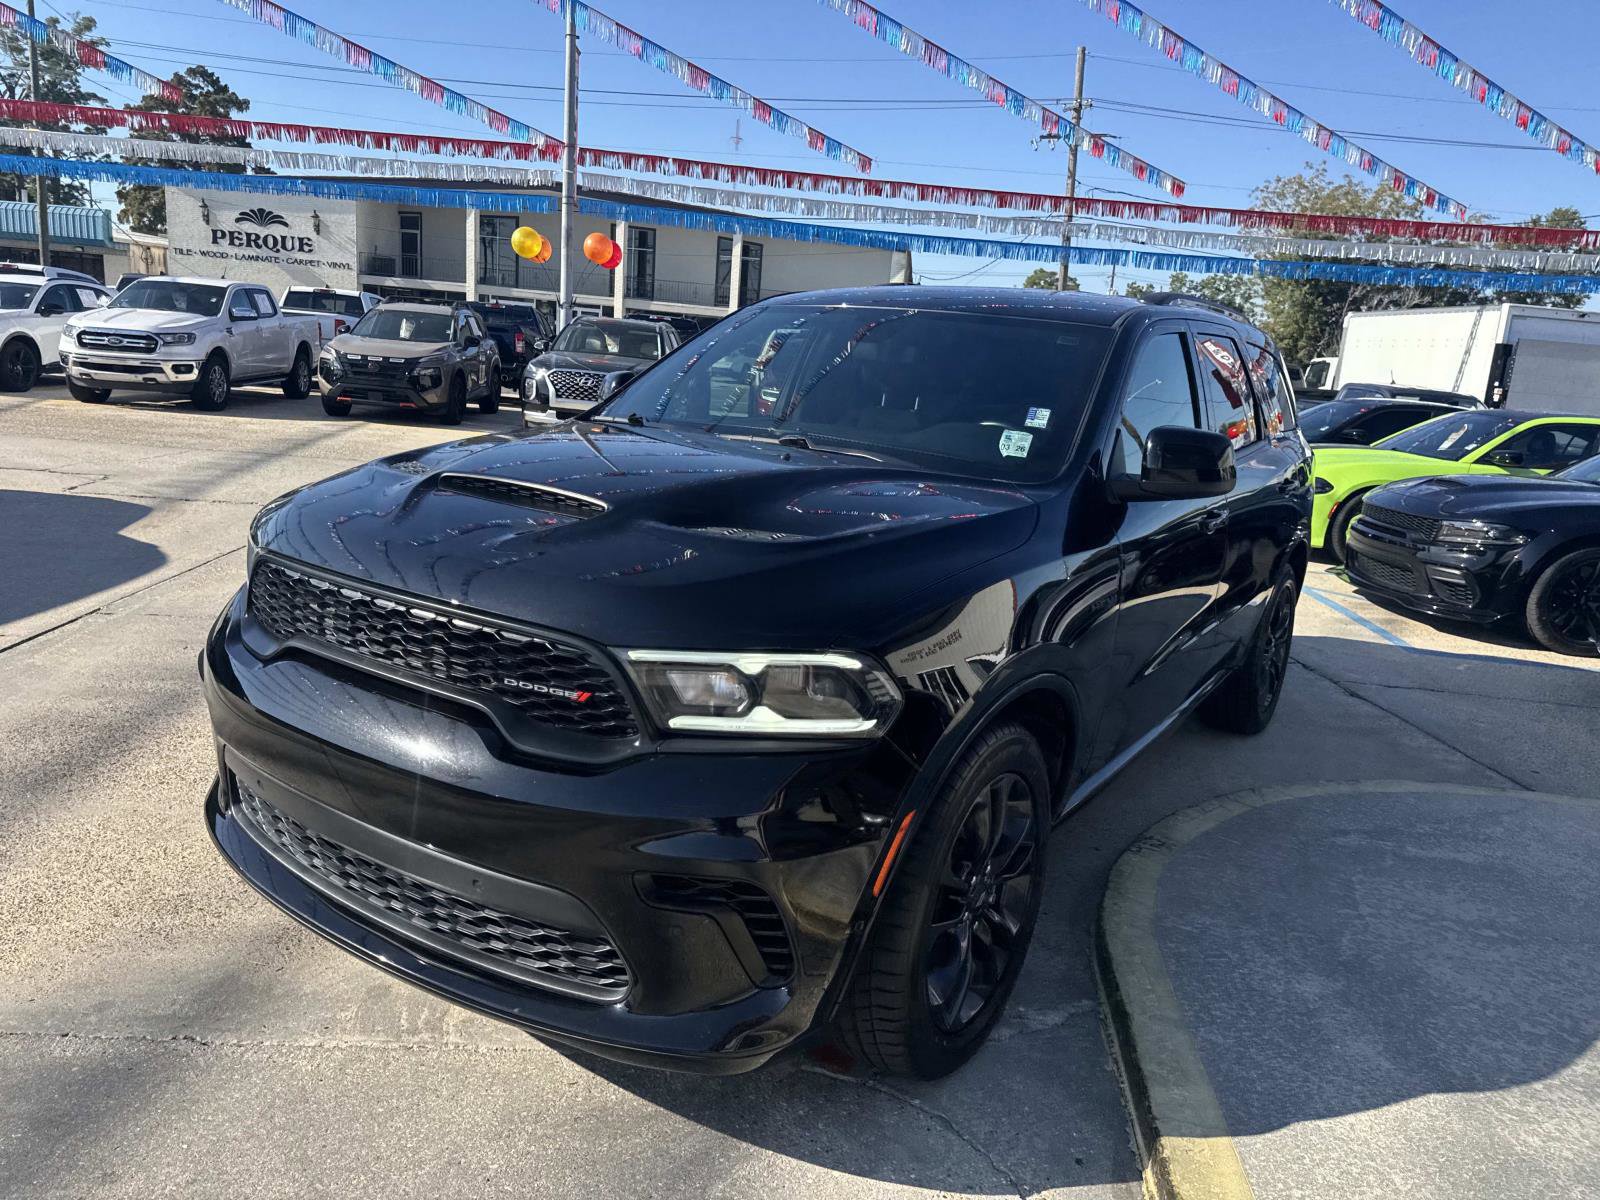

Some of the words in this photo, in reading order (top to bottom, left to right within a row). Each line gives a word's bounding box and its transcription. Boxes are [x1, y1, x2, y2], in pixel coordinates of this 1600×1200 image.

[211, 228, 314, 253] PERQUE
[173, 247, 193, 256] TILE
[199, 251, 229, 259] WOOD
[235, 252, 280, 264] LAMINATE
[286, 257, 321, 268] CARPET
[326, 261, 353, 271] VINYL
[1015, 445, 1026, 453] 26
[504, 678, 579, 700] DODGE
